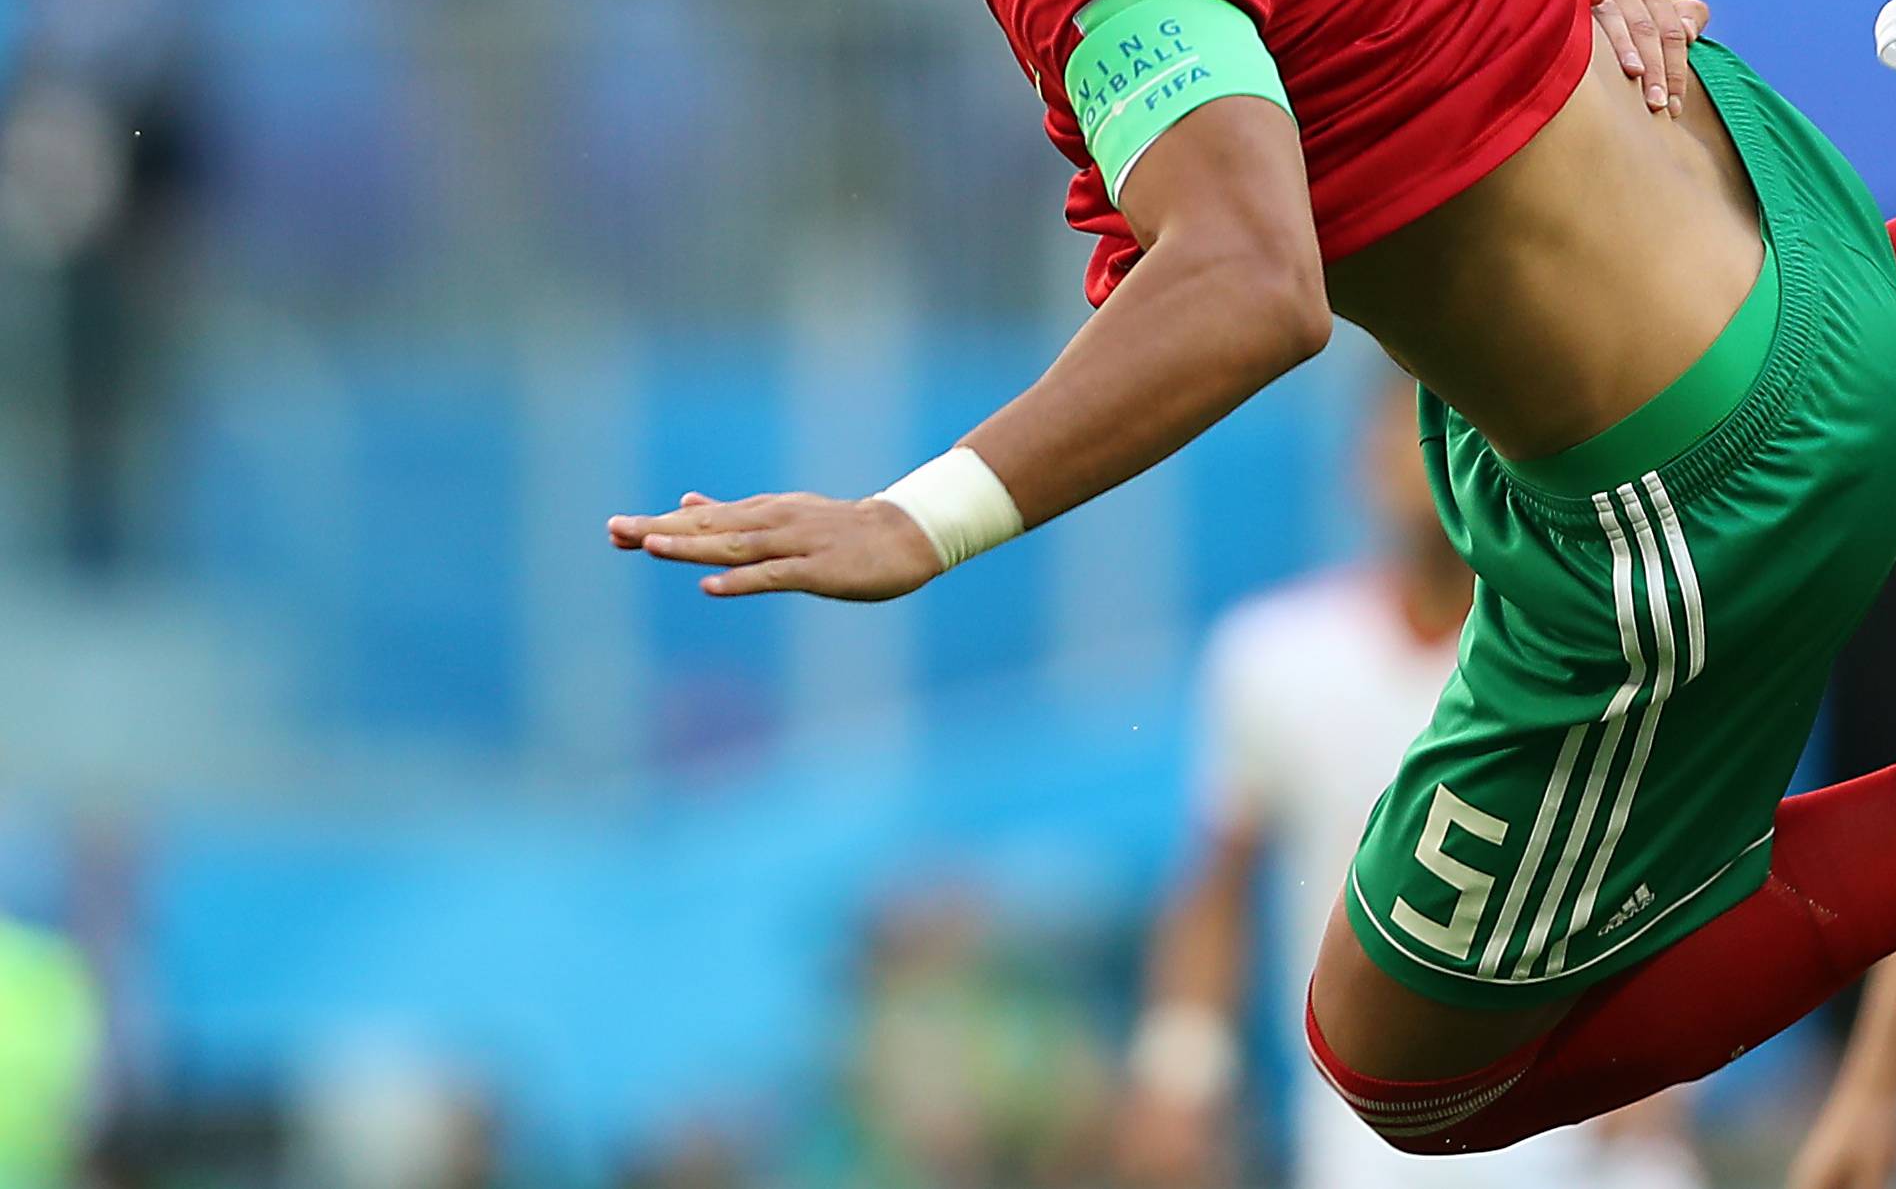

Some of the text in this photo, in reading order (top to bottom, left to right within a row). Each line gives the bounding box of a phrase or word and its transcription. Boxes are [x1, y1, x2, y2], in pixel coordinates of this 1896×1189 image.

[1079, 39, 1193, 128] OTBALL
[1144, 64, 1212, 111] FIFA
[1389, 782, 1510, 962] 5
